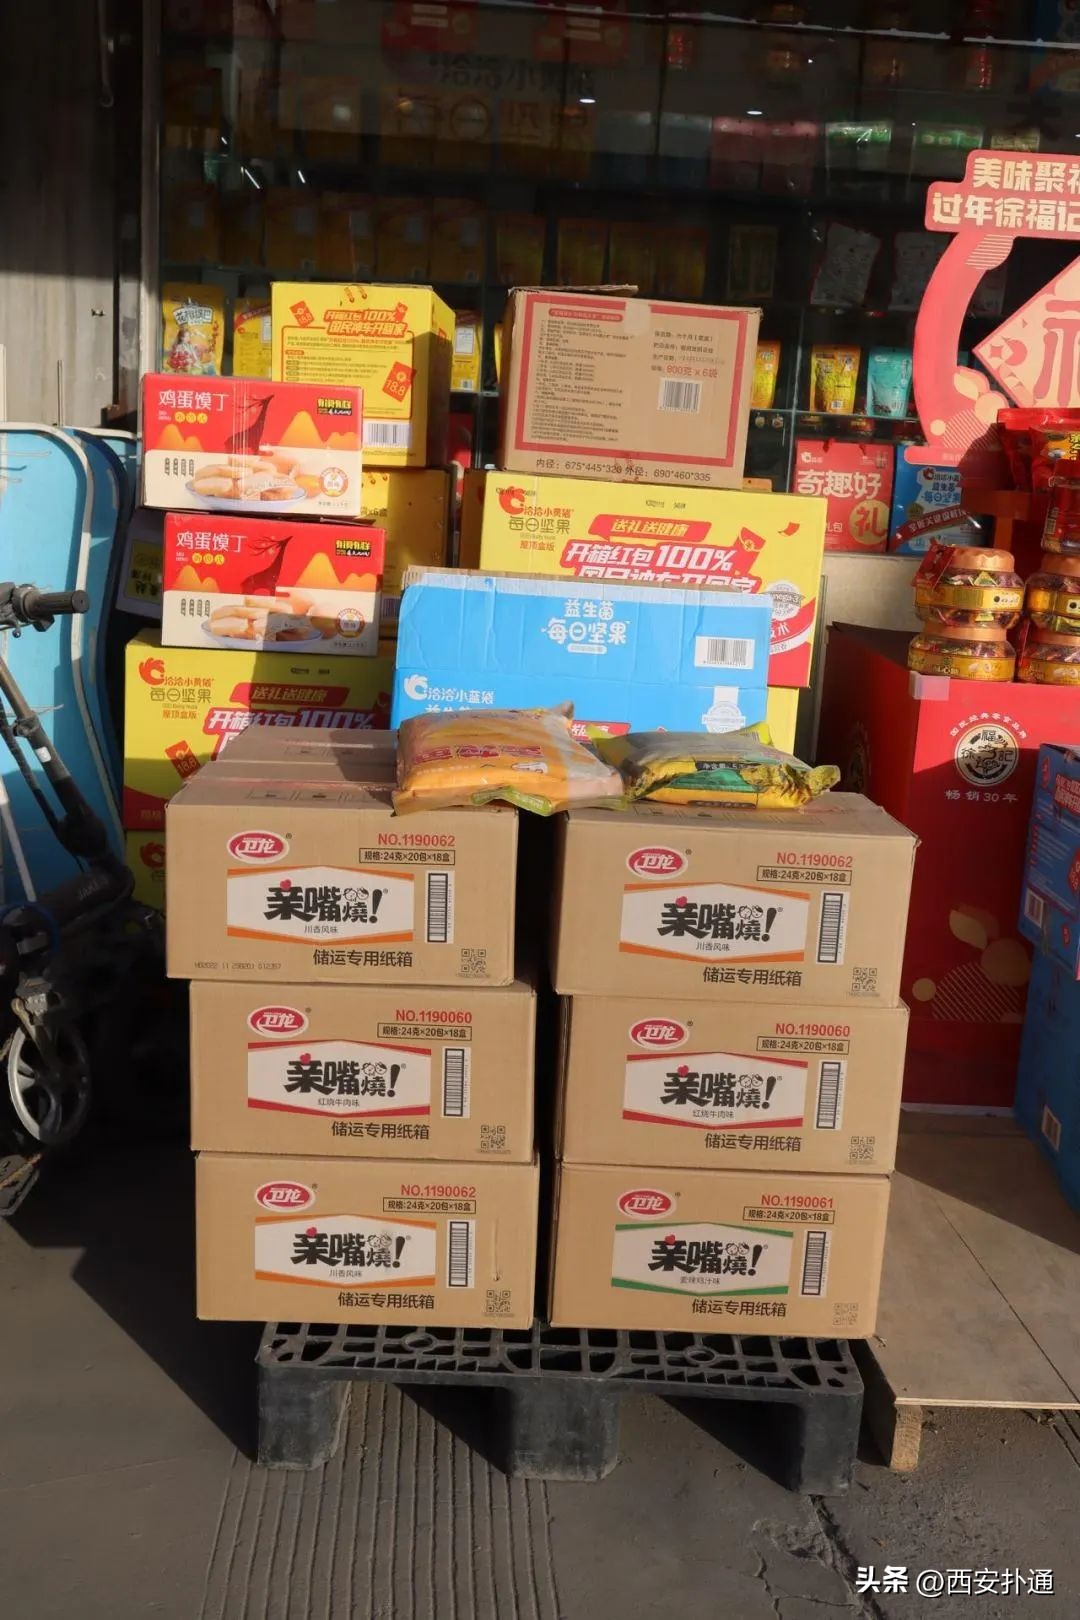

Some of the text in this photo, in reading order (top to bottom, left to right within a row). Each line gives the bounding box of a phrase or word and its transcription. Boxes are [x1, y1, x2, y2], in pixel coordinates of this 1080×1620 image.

[932, 192, 1080, 232] 过年徐福记
[386, 379, 406, 396] 18.8
[158, 389, 230, 412] 鸡蛋馍丁
[797, 469, 881, 500] 奇趣好
[508, 516, 570, 535] 每日坚果
[611, 519, 689, 537] 送礼送健康
[856, 506, 887, 537] 礼
[176, 531, 248, 553] 鸡蛋馍丁
[566, 542, 737, 572] 开箱红包100%
[564, 599, 614, 620] 益生菌
[547, 618, 626, 645] 每日坚果
[150, 687, 212, 705] 每日坚果
[378, 833, 456, 847] NO.1190062
[777, 852, 853, 868] NO.1190062
[304, 925, 338, 934] 川香风味
[696, 942, 730, 952] 川香风味
[313, 950, 413, 968] 储运专用纸箱
[703, 966, 803, 987] 储运专用纸箱
[396, 1010, 472, 1024] NO.1190060
[775, 1023, 850, 1037] NO.1190060
[332, 1121, 430, 1140] 储运专用纸箱
[705, 1133, 801, 1152] 储运专用纸箱
[401, 1184, 476, 1198] NO.1190062
[761, 1194, 834, 1208] NO.1190061
[329, 1268, 362, 1278] 川香风味
[338, 1292, 435, 1309] 储运专用纸箱
[692, 1299, 786, 1317] 储运专用纸箱
